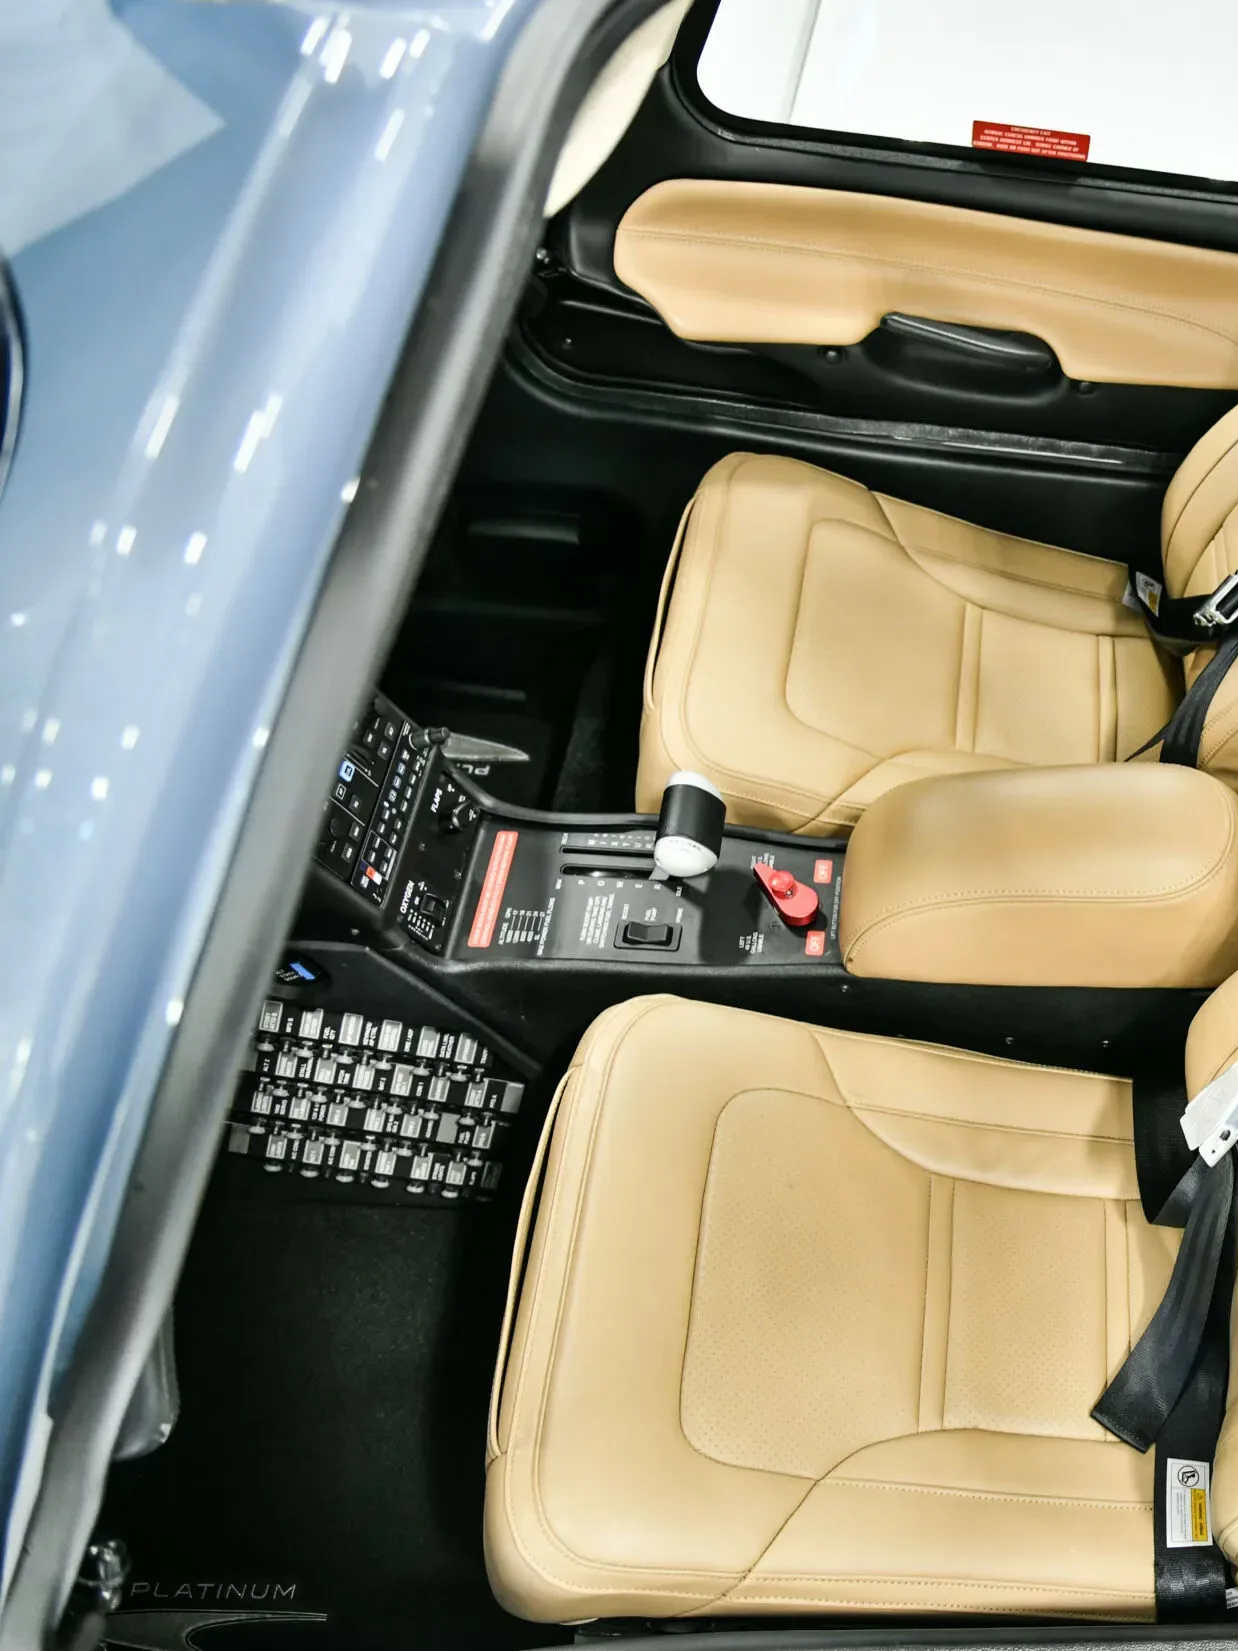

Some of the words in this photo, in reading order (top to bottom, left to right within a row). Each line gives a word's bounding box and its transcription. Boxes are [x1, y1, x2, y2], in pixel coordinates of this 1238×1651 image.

[431, 788, 443, 813] FLAPS
[400, 880, 415, 914] OXYGEN
[750, 932, 759, 954] GALLONS
[809, 935, 819, 952] OFF
[323, 1026, 331, 1039] FUEL
[129, 1582, 297, 1601] PLATINUM
